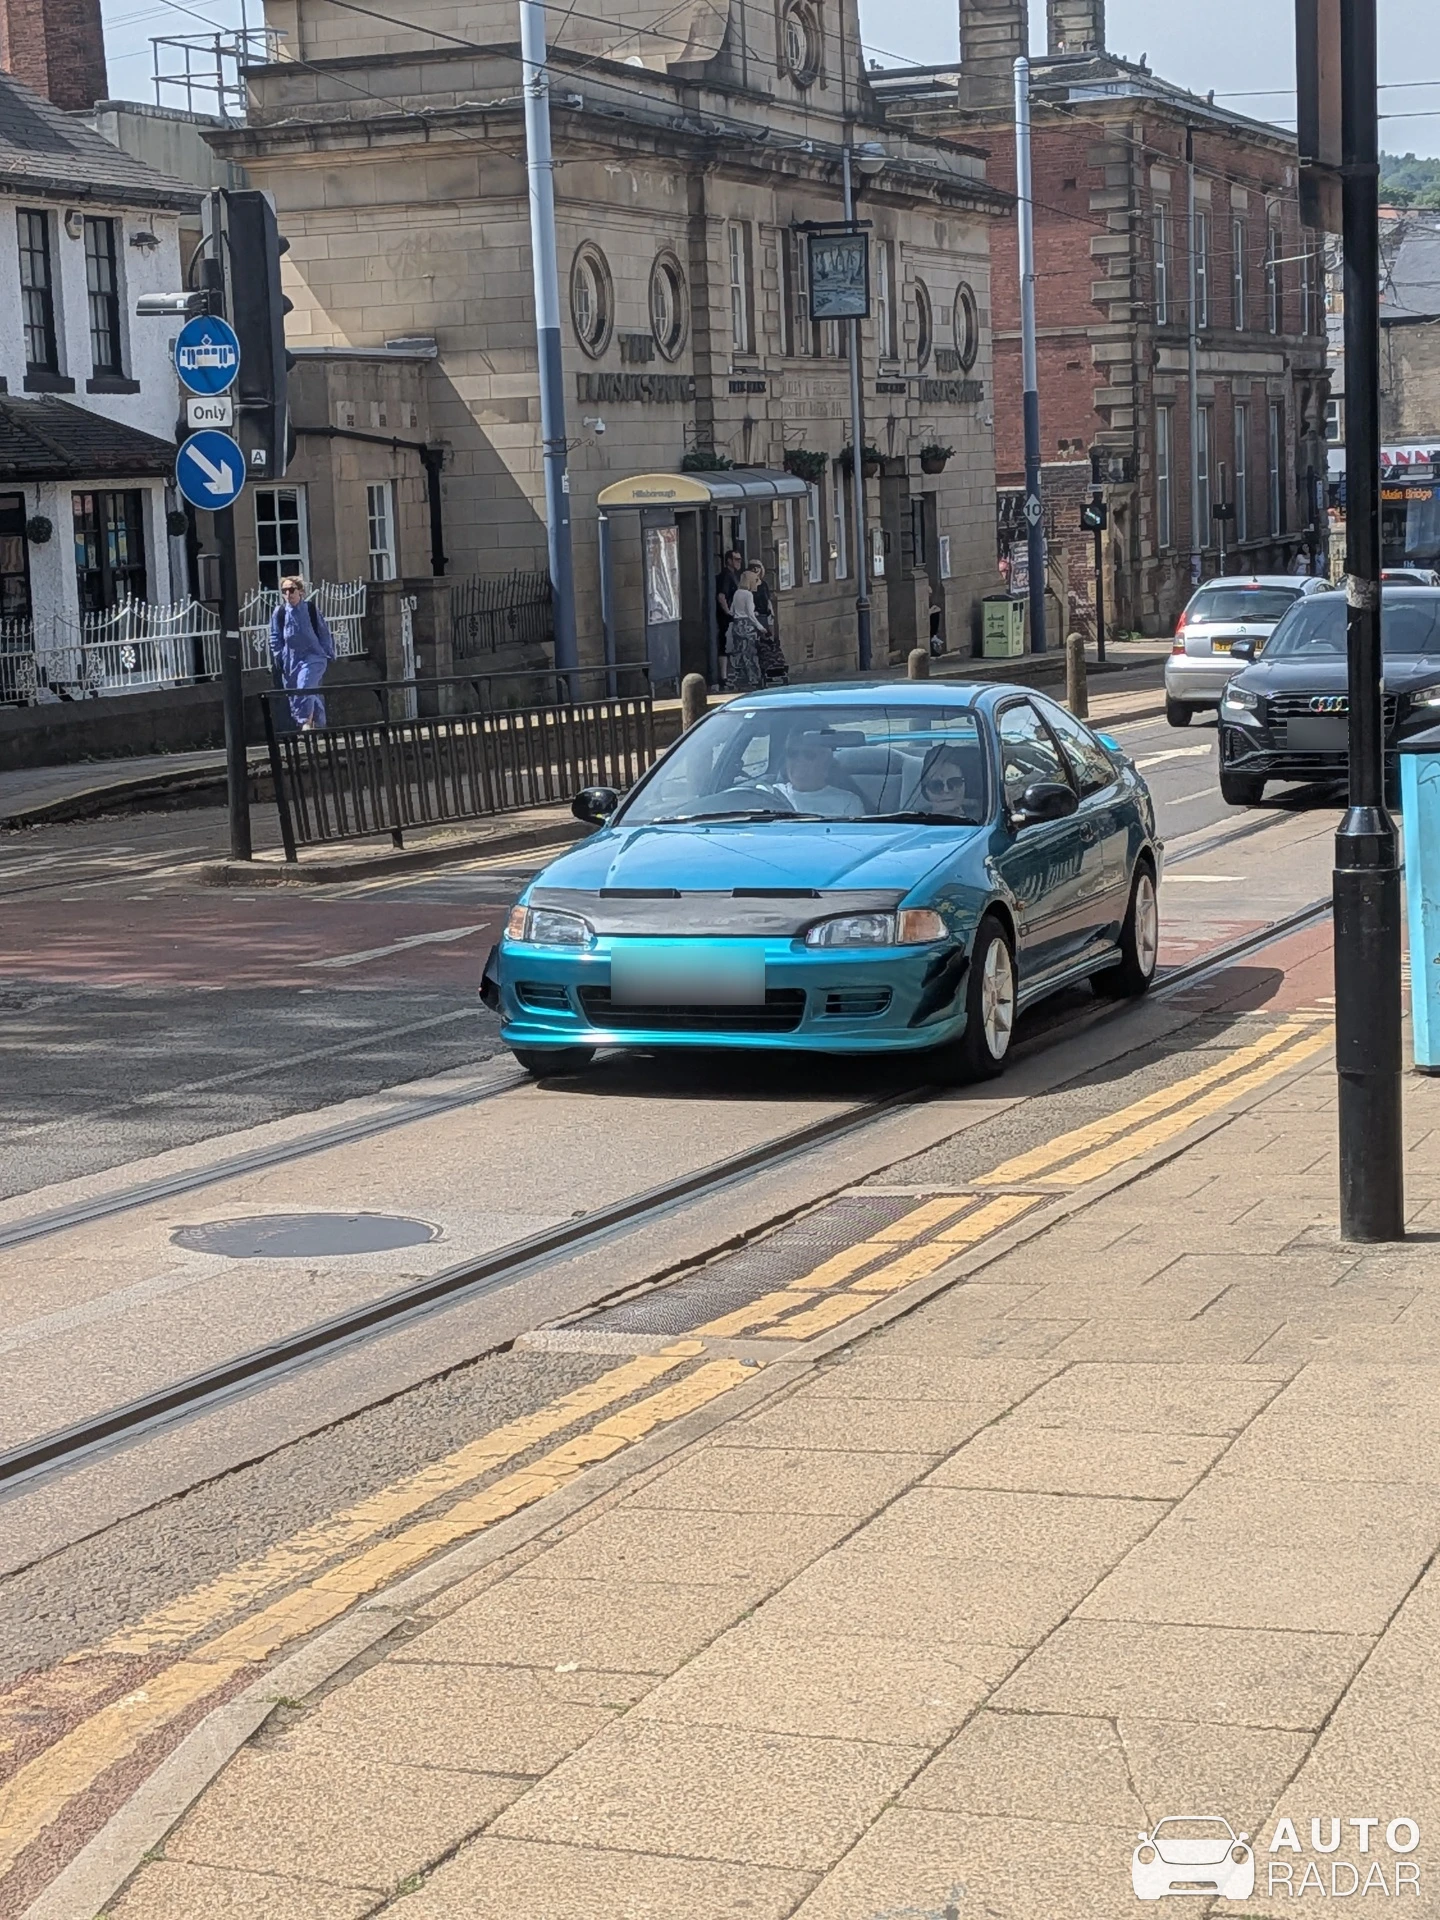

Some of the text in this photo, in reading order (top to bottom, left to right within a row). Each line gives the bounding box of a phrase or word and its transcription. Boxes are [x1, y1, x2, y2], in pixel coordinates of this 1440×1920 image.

[193, 405, 226, 421] Only
[253, 451, 264, 463] A
[632, 489, 676, 499] Hillsborough
[1405, 487, 1432, 501] Bridge
[1025, 503, 1042, 516] 10
